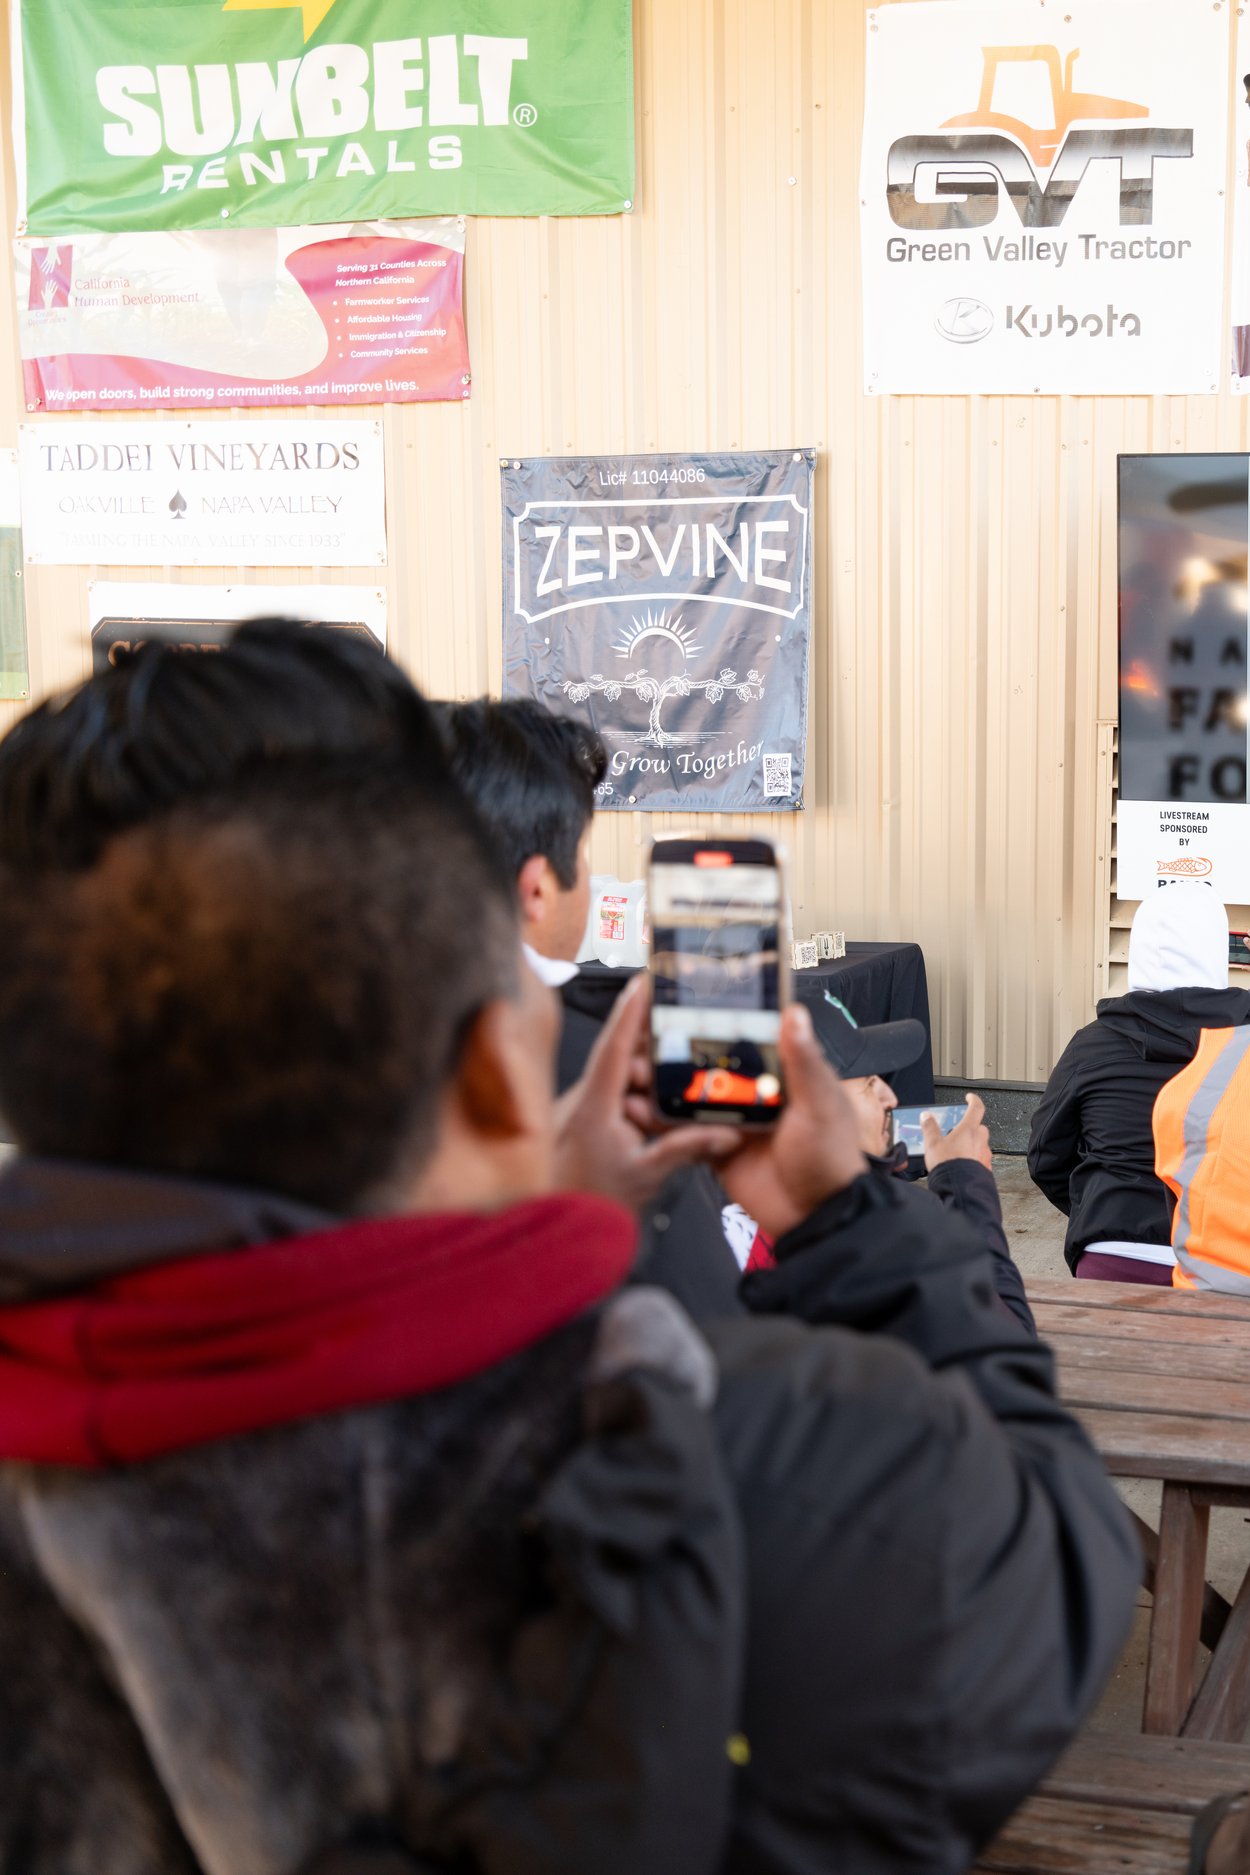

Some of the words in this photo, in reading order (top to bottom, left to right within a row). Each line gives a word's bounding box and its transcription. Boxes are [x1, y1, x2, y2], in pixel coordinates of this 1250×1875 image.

[95, 34, 529, 157] SUNBELT
[160, 134, 463, 195] RENTALS
[886, 127, 1194, 230] GVT
[886, 237, 971, 263] Green
[982, 235, 1068, 268] Valley
[1078, 233, 1192, 260] Tractor
[337, 264, 368, 273] Serving
[370, 263, 379, 272] 31
[380, 260, 415, 270] Counties
[417, 259, 447, 267] Across
[75, 277, 130, 290] California
[335, 279, 371, 287] Northern
[373, 276, 415, 285] California
[75, 296, 119, 307] Human
[122, 292, 200, 306] Development
[345, 297, 395, 306] Farmworker
[396, 296, 429, 304] Services
[347, 314, 390, 323] Affordable
[392, 313, 422, 323] Housing
[1005, 304, 1141, 337] Kubota
[349, 331, 396, 342] Immigration
[398, 331, 403, 339] &
[405, 328, 446, 339] Citizenship
[350, 348, 393, 358] Community
[395, 346, 428, 356] Services
[46, 390, 64, 401] We
[66, 390, 96, 402] open
[99, 388, 137, 401] doors,
[140, 386, 170, 399] build
[173, 387, 214, 401] strong
[217, 384, 301, 398] communities,
[305, 382, 328, 395] and
[332, 381, 382, 395] improve
[386, 379, 420, 391] lives.
[40, 443, 153, 472] TADDEI
[167, 441, 360, 471] VINEYARDS
[599, 470, 627, 486] Lic#
[632, 468, 705, 484] 11044086
[59, 496, 155, 514] OAKVILLE
[201, 496, 254, 513] NAPA
[259, 496, 342, 513] VALLEY
[534, 520, 792, 598] ZEPVINE
[611, 750, 671, 776] Grow
[676, 740, 764, 779] Together
[1160, 811, 1209, 820] LIVESTREAM
[1160, 824, 1208, 833] SPONSORED
[1179, 838, 1190, 846] BY
